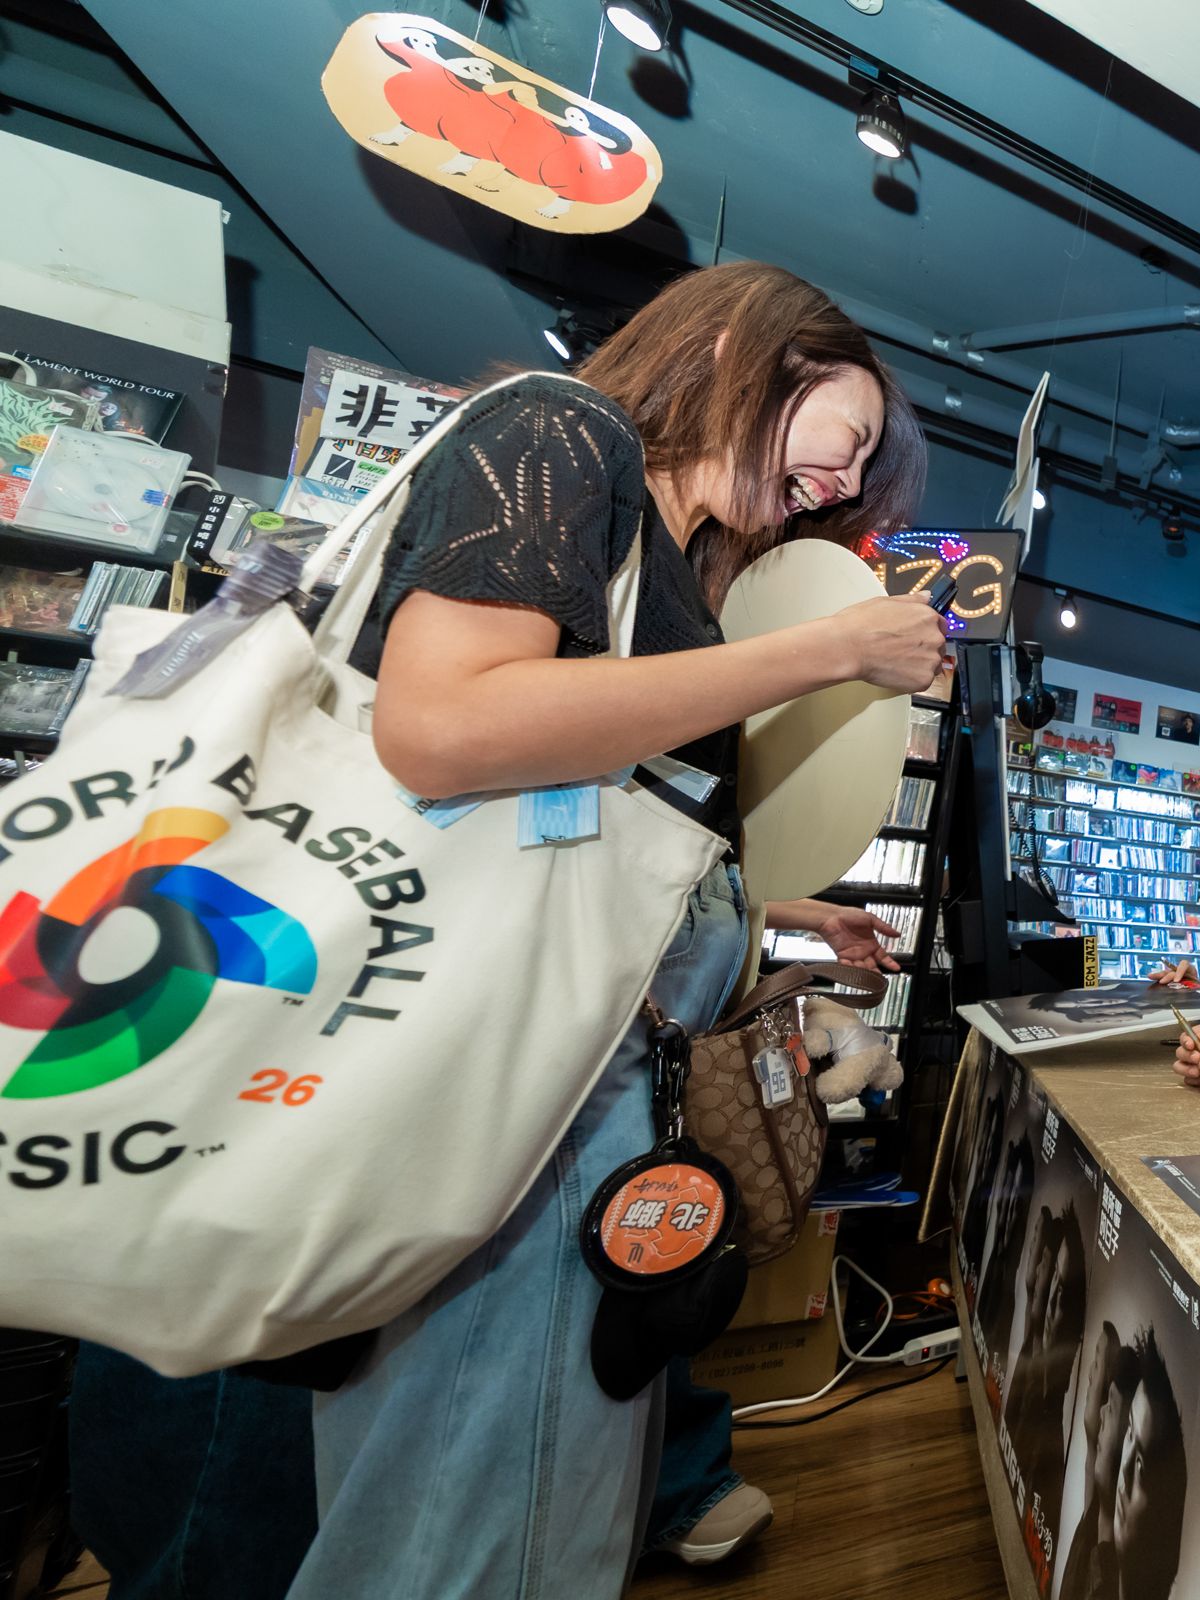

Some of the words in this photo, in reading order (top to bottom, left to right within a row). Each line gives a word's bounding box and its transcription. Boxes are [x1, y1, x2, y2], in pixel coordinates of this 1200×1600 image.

[84, 371, 136, 390] WORLD
[138, 385, 176, 400] TOUR
[212, 752, 435, 1038] BASEBALL
[1085, 937, 1095, 967] JAZZ
[1085, 968, 1095, 988] ECM
[239, 1068, 324, 1107] 26
[0, 1120, 187, 1190] SIC
